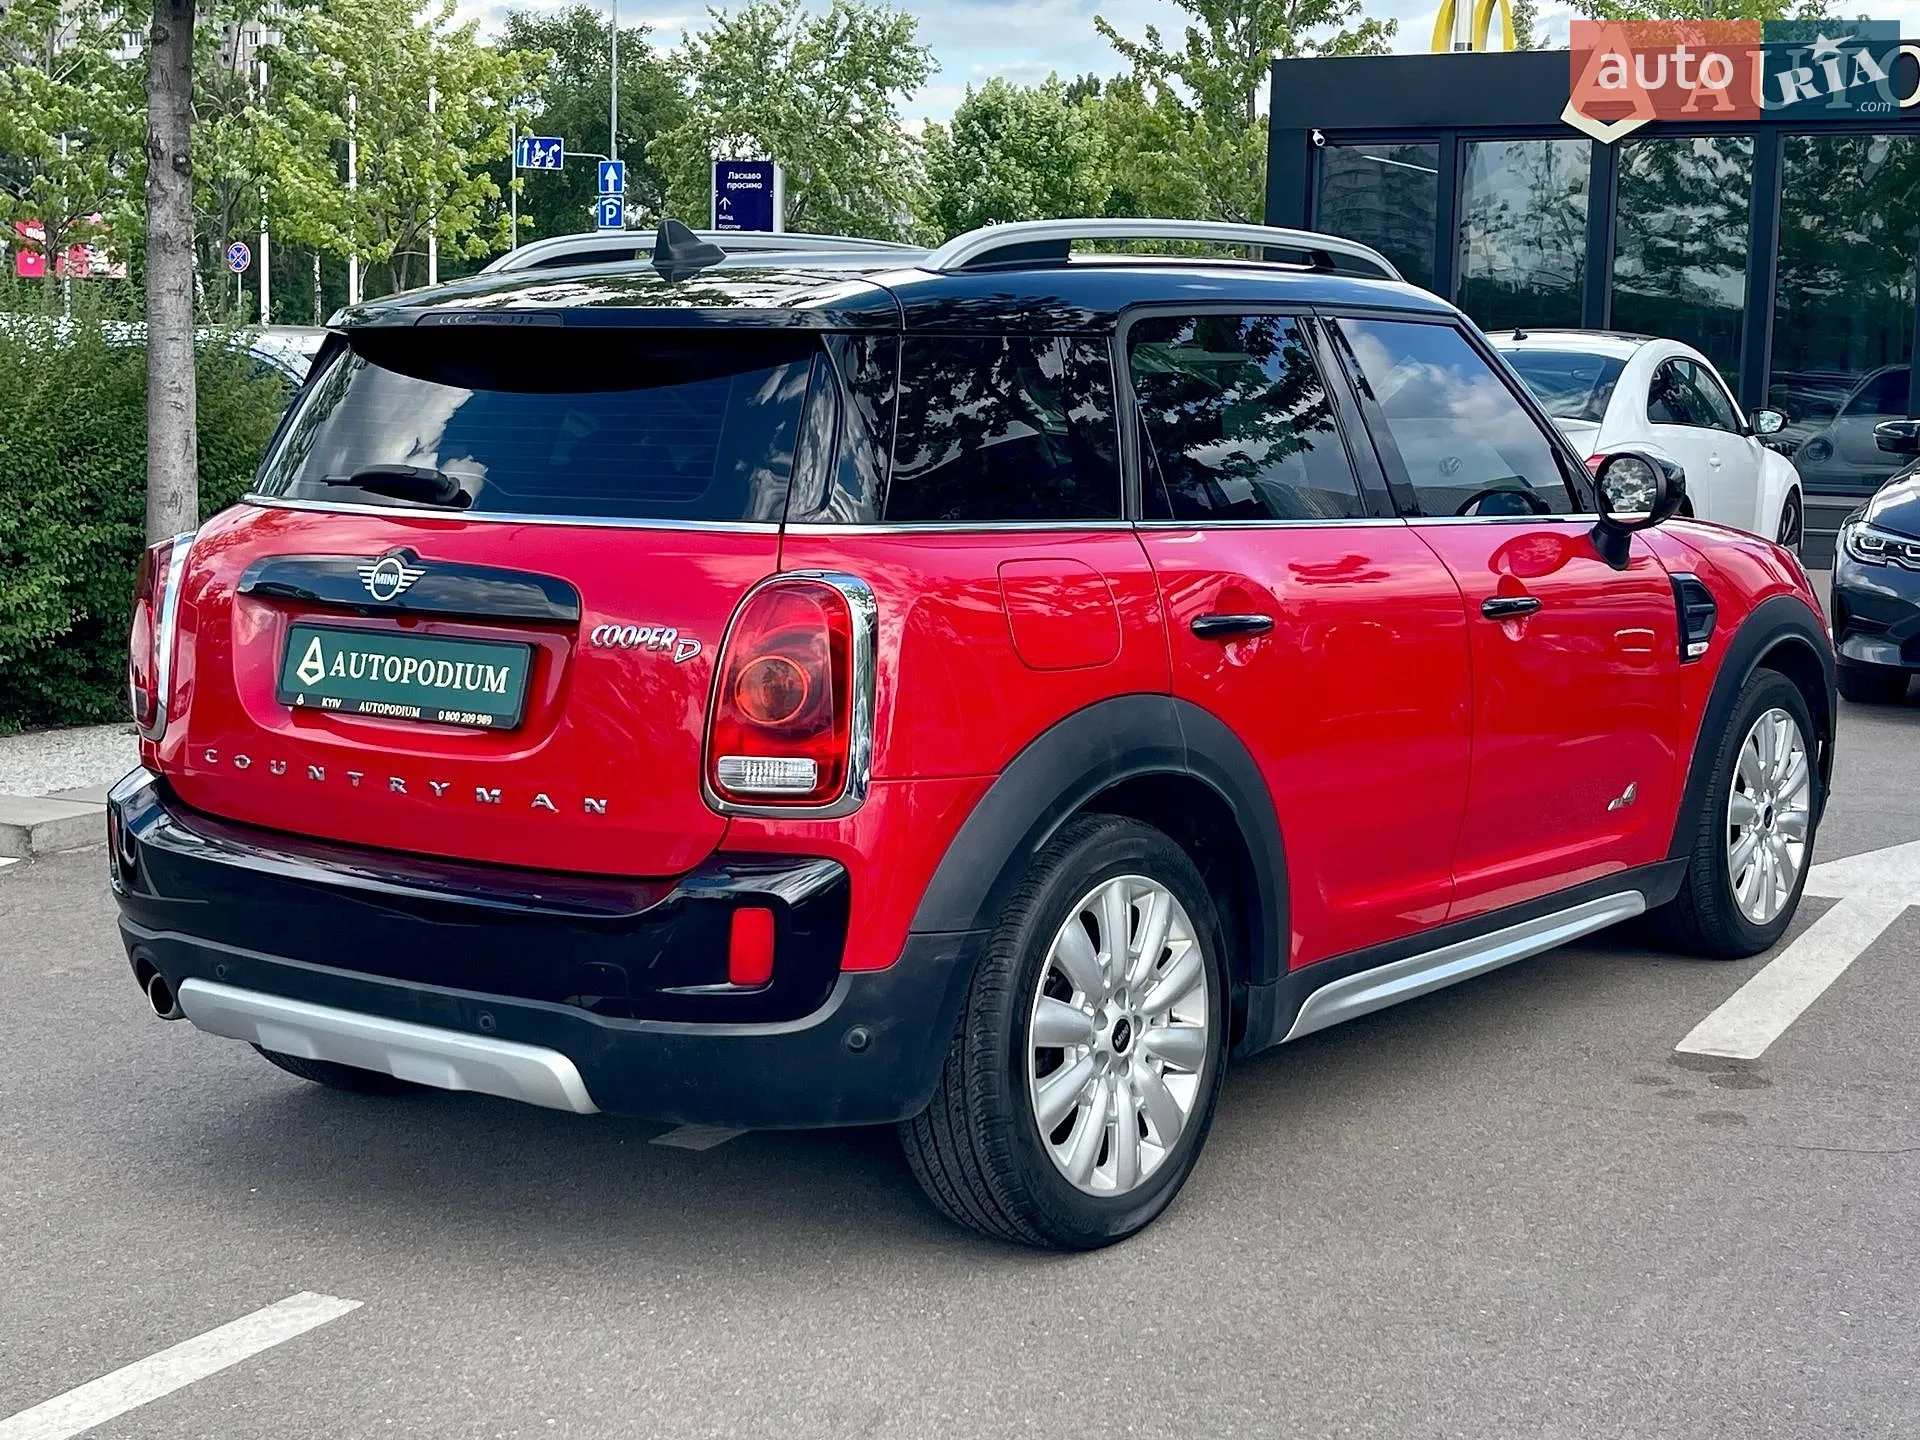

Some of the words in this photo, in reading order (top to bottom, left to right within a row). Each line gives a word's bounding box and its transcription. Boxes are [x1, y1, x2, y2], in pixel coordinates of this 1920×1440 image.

[726, 182, 763, 191] просимо
[728, 171, 762, 180] Ласкаво
[605, 204, 617, 226] P
[374, 572, 399, 586] MINI
[590, 624, 678, 652] COOPER
[673, 638, 702, 664] D
[329, 650, 511, 694] AUTOPODIUM
[321, 697, 343, 709] KYIV
[358, 701, 422, 718] AUTOPODIUM
[445, 710, 461, 722] 800
[460, 712, 477, 724] 209
[203, 748, 608, 815] COUNTRYMAN
